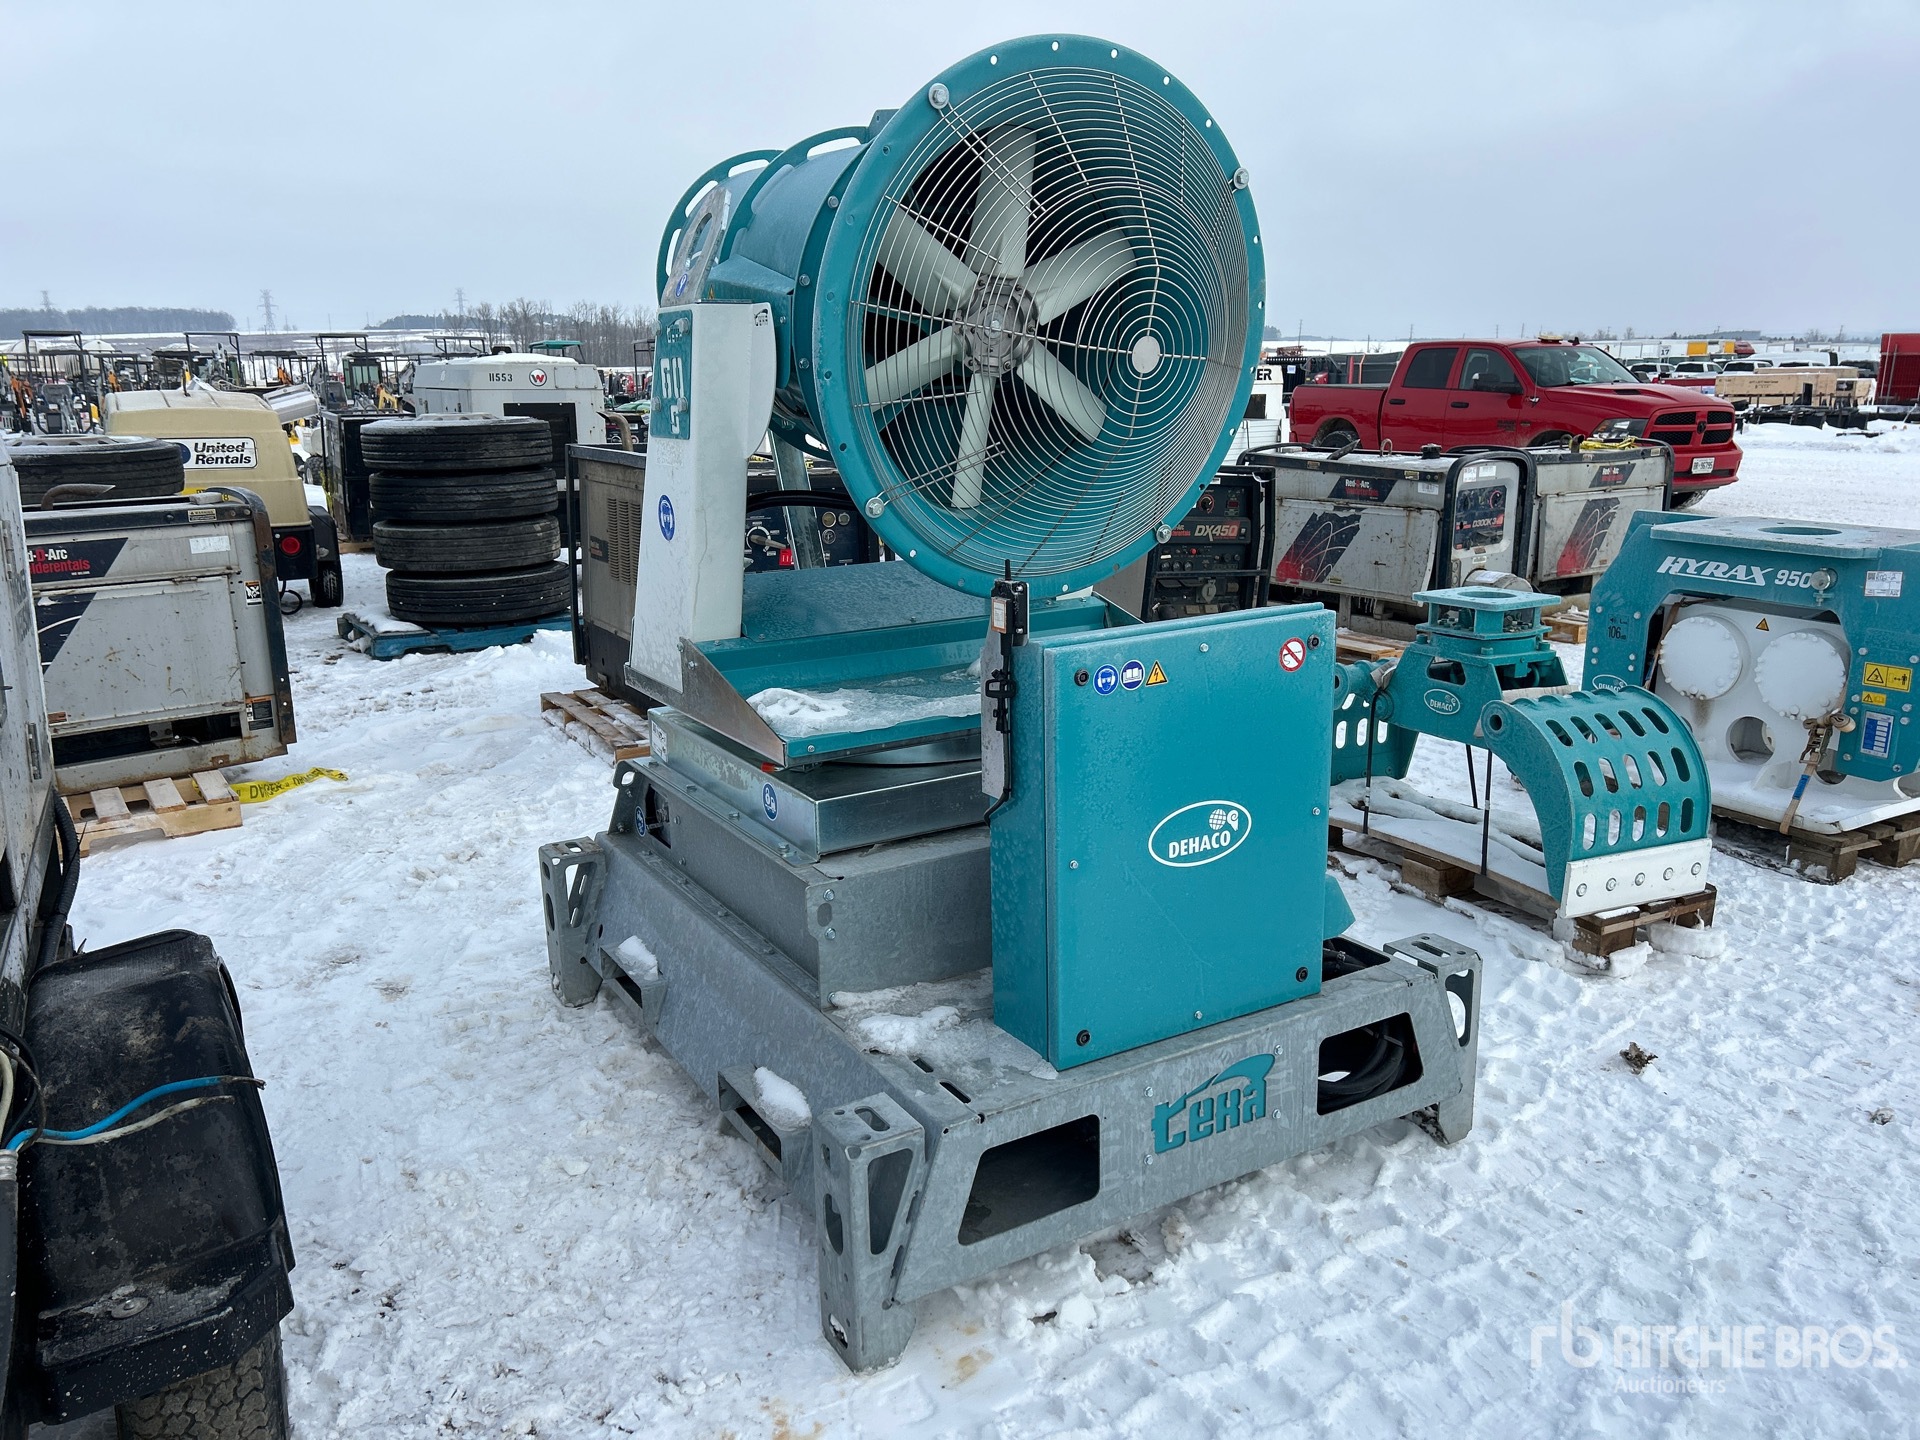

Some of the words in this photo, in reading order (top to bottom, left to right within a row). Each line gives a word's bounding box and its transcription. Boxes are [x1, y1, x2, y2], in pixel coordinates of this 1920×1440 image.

[488, 372, 513, 382] 11553
[1255, 368, 1272, 381] ER
[193, 442, 246, 453] United
[195, 453, 252, 465] Rentals
[1194, 524, 1240, 542] DX450
[1656, 555, 1774, 587] HYRAX
[1774, 569, 1812, 589] 950
[1430, 698, 1453, 712] DEHACO
[1168, 830, 1231, 859] DEHACO
